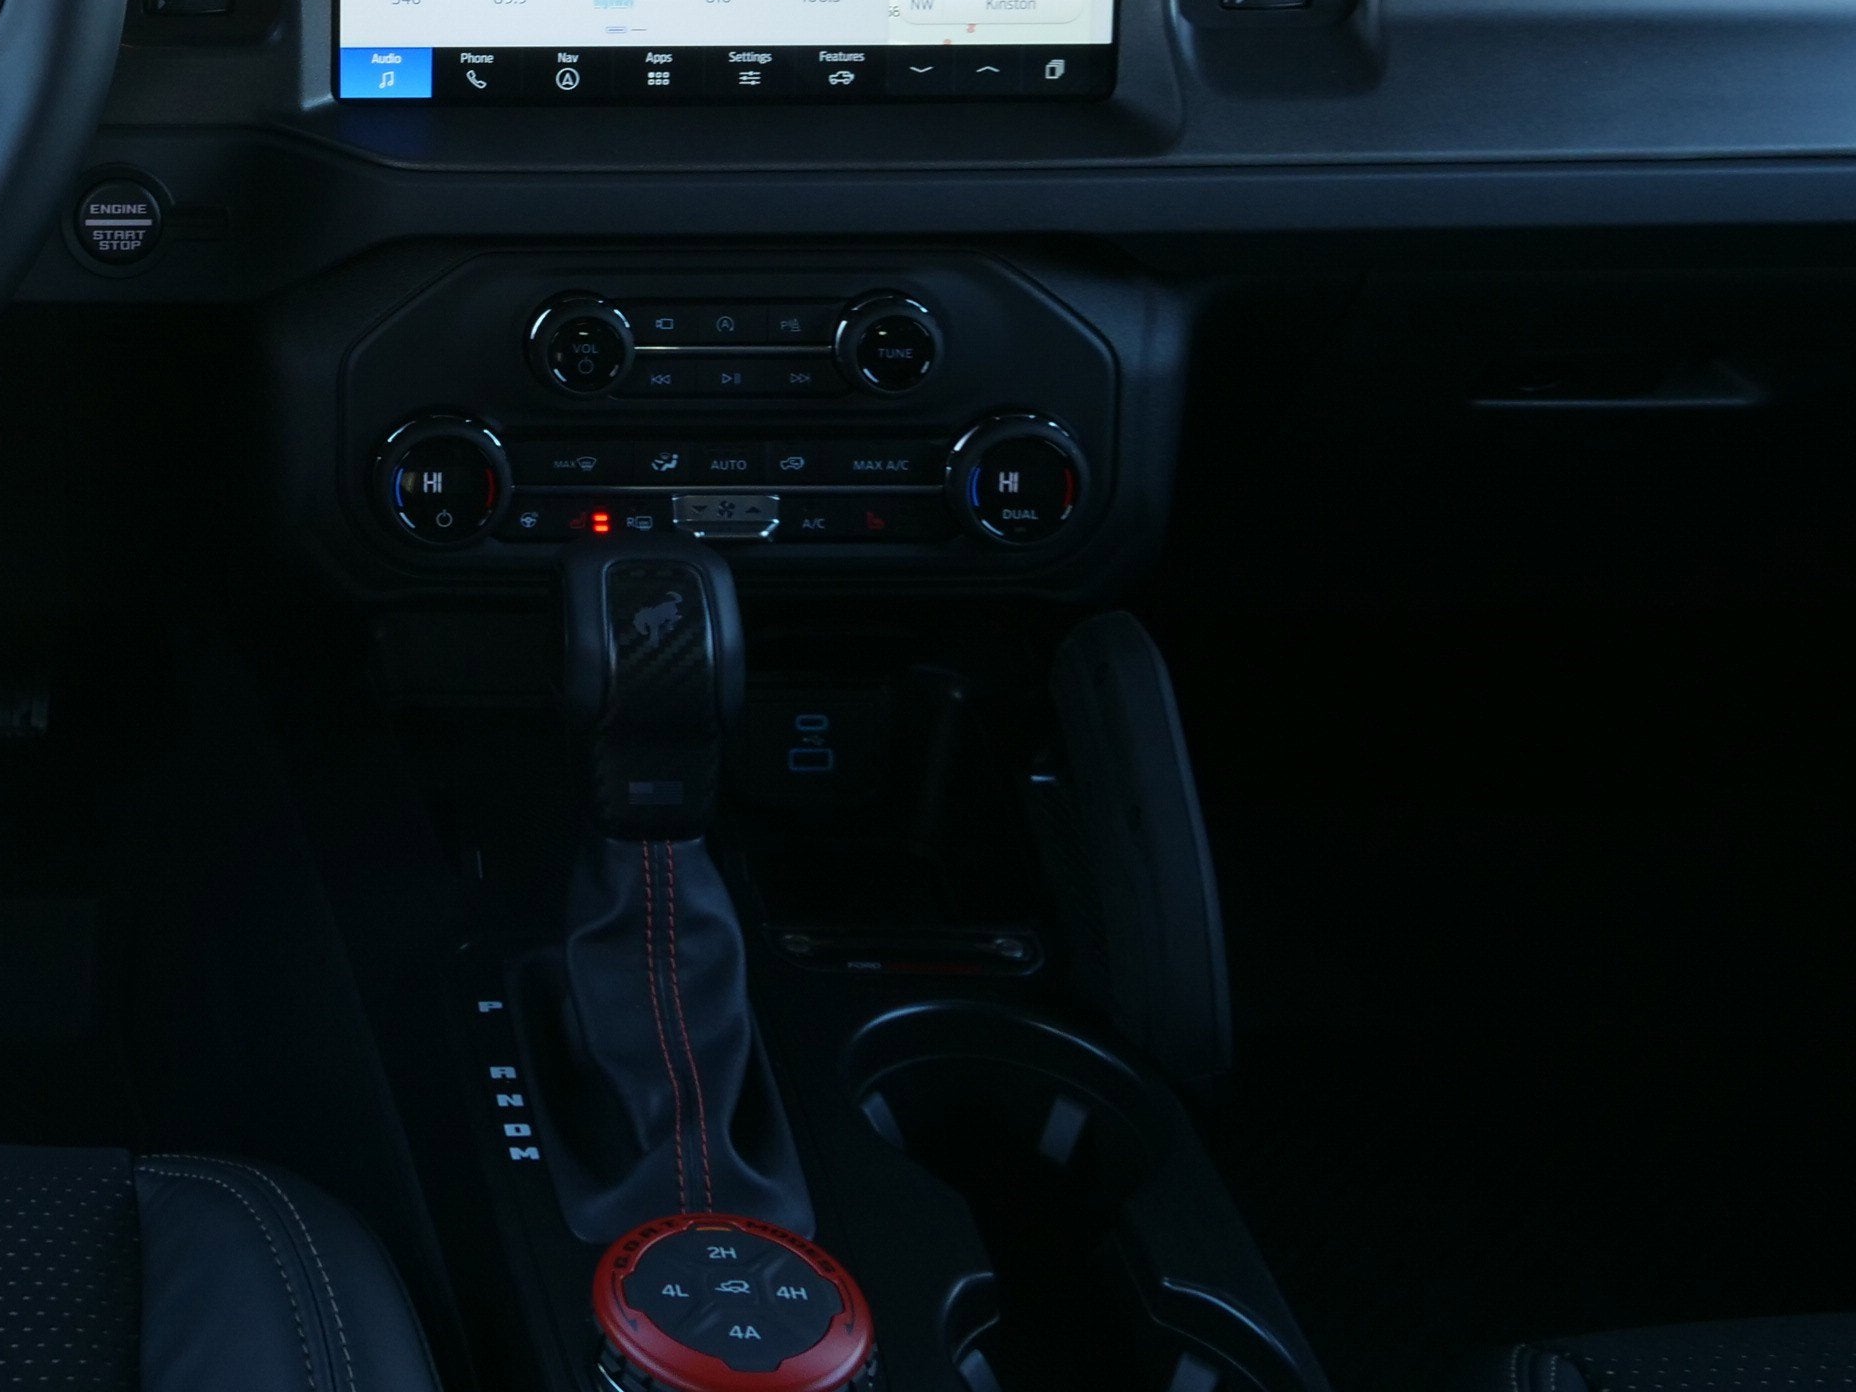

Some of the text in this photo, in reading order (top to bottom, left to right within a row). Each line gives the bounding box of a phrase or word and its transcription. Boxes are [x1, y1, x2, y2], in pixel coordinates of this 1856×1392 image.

[371, 52, 402, 65] Audio
[460, 52, 494, 64] Phone
[557, 52, 579, 64] Nav
[645, 52, 673, 67] Apps
[728, 51, 772, 65] Settings
[819, 50, 865, 63] Features
[90, 204, 147, 215] ENGINE
[93, 230, 146, 240] START
[99, 240, 142, 251] STOP
[571, 343, 599, 355] VOL
[877, 347, 915, 359] TUNE
[710, 459, 747, 471] AUTO
[852, 459, 909, 472] MAX A/C
[422, 471, 443, 495] HI
[998, 471, 1020, 495] HI
[1002, 508, 1039, 521] DUAL
[802, 517, 826, 531] A/C
[496, 1094, 524, 1107] N
[504, 1123, 532, 1137] D
[509, 1146, 540, 1160] M
[706, 1246, 738, 1260] 2H
[661, 1284, 690, 1298] 4L
[776, 1285, 809, 1300] 4H
[728, 1325, 761, 1340] 4A
